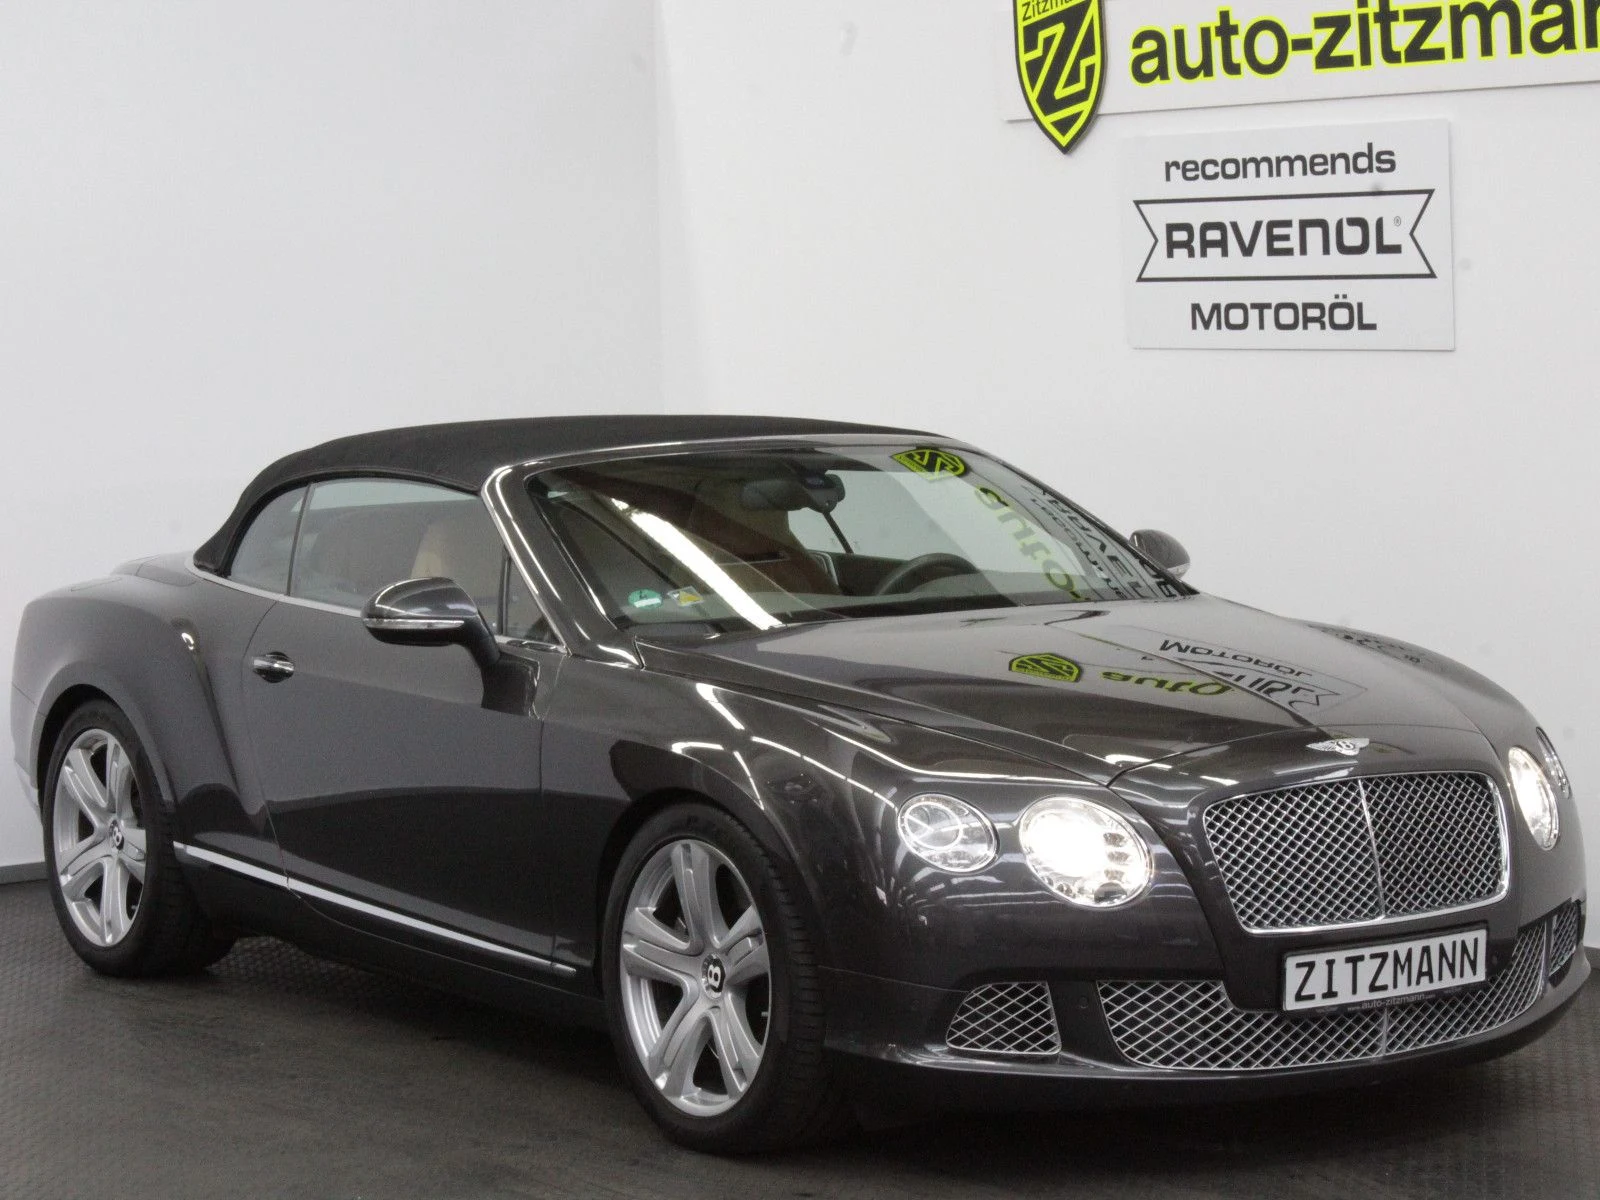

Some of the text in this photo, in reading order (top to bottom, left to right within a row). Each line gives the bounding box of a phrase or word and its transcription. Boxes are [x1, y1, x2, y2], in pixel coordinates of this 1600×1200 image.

[1165, 142, 1396, 182] recommends
[1191, 294, 1377, 330] MOTORÖL
[1294, 937, 1479, 1002] ZITZMANN
